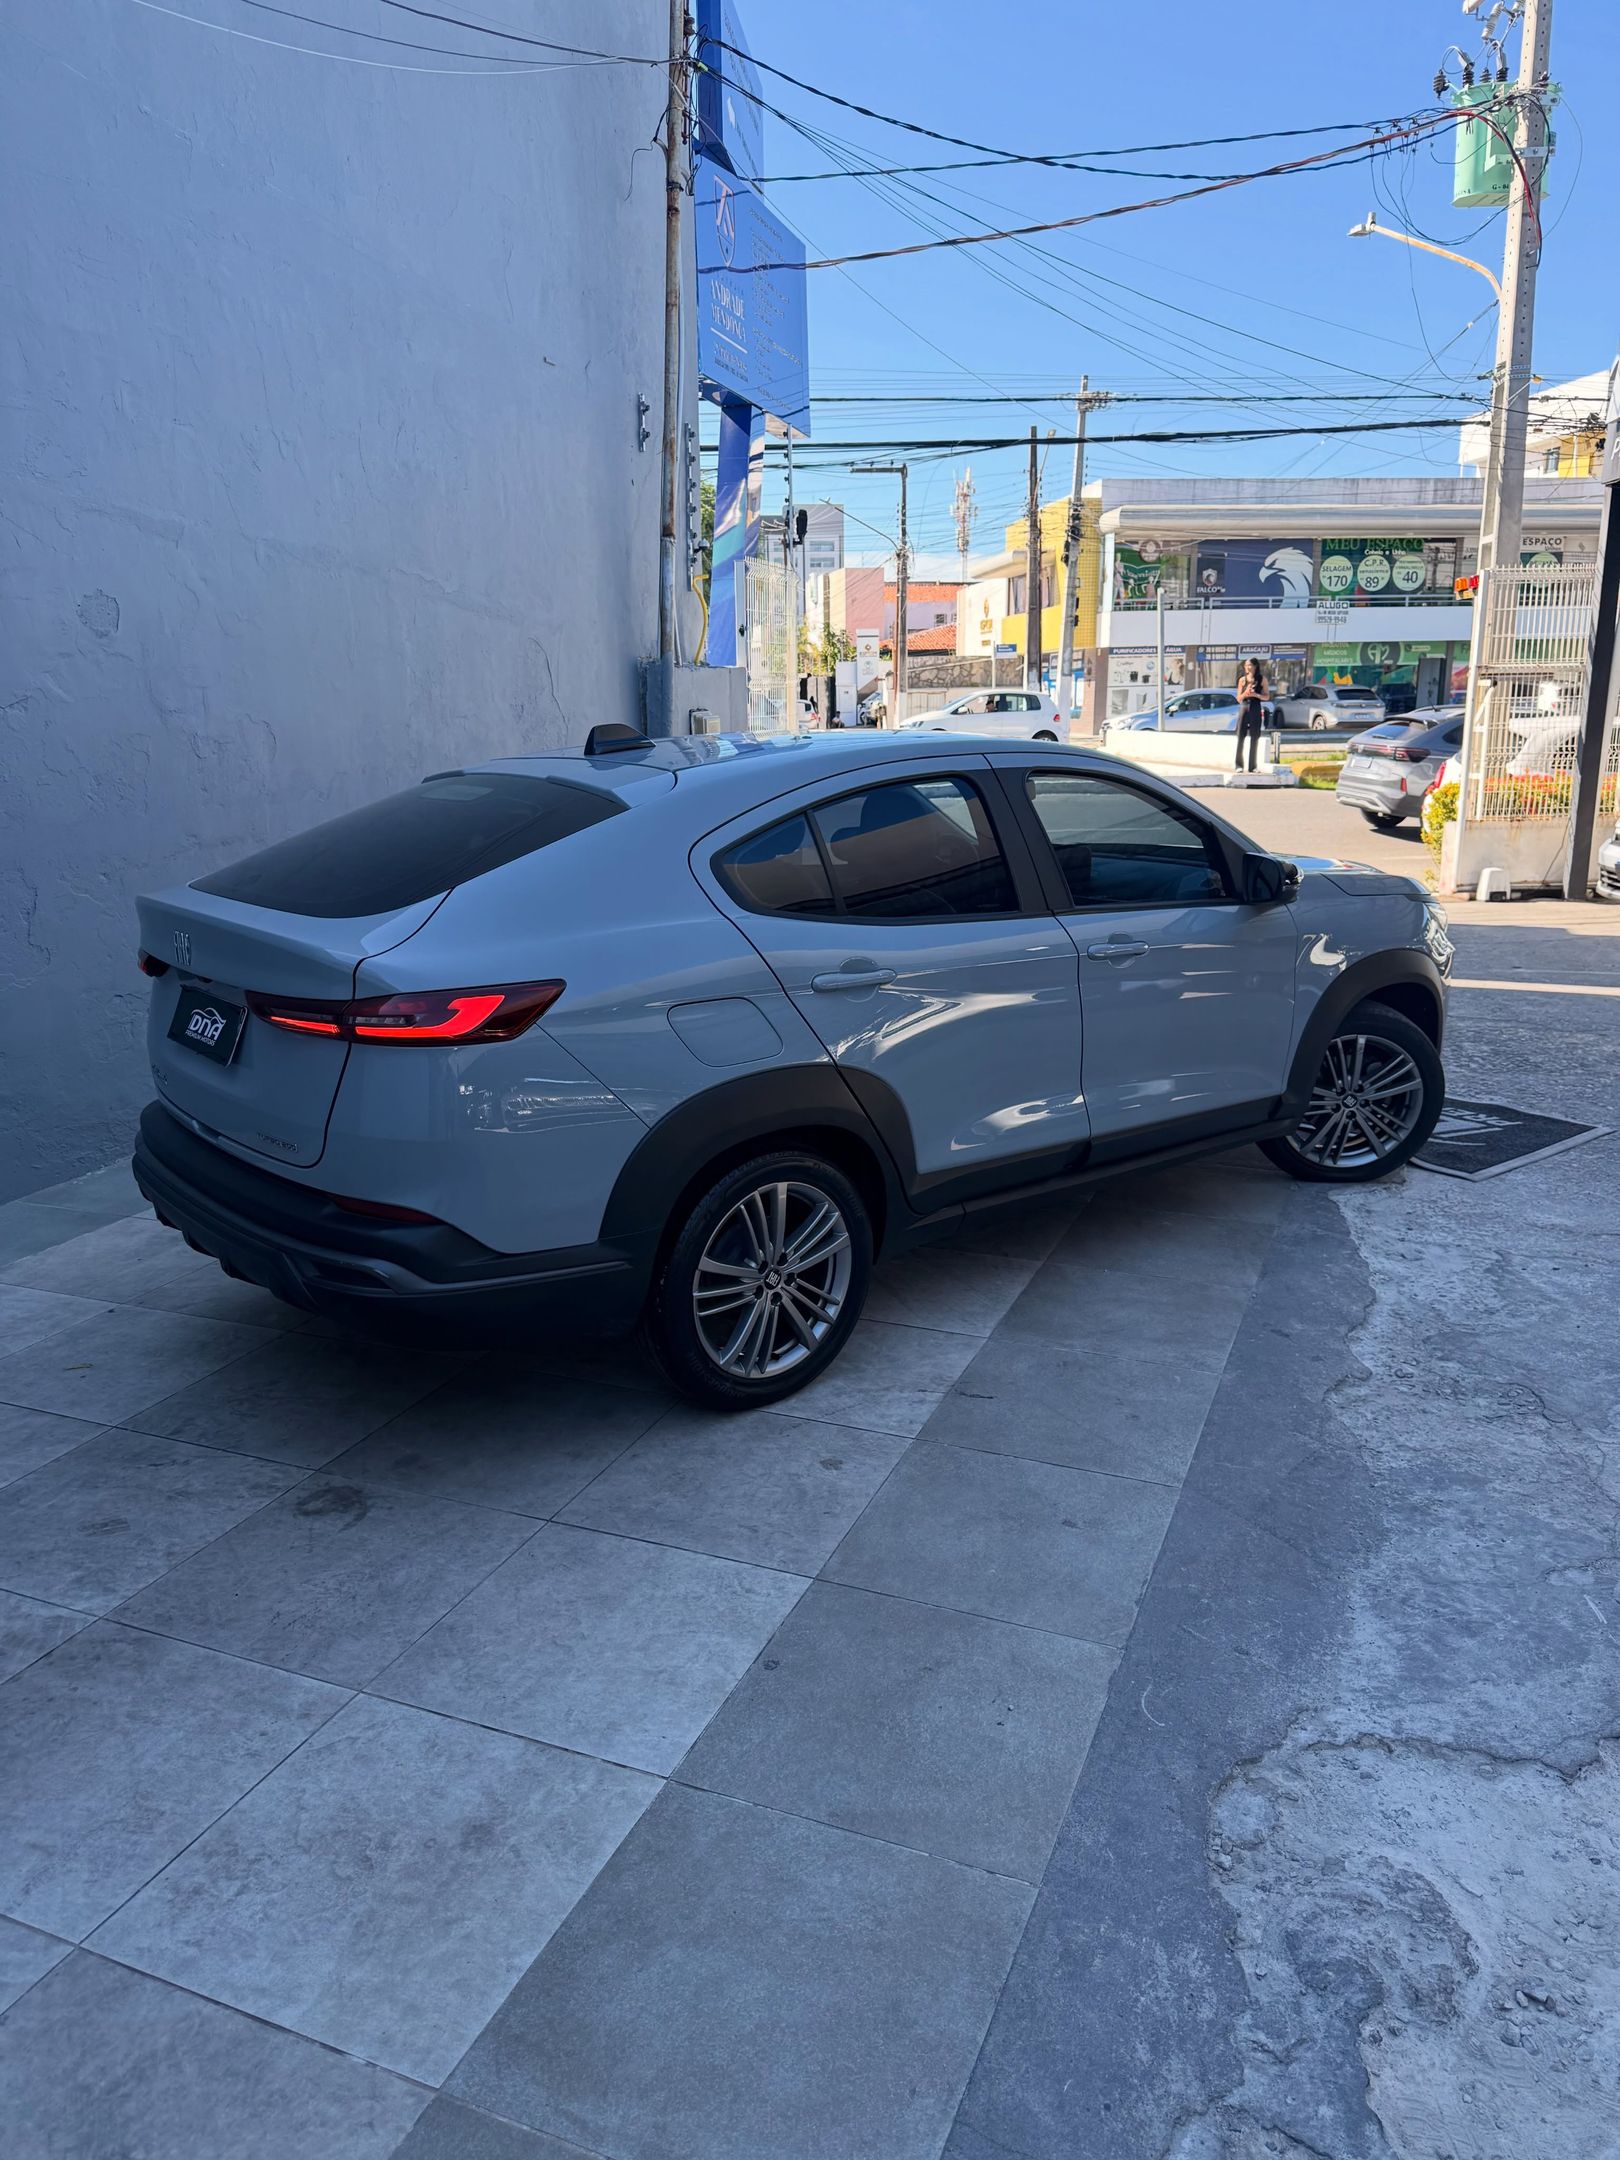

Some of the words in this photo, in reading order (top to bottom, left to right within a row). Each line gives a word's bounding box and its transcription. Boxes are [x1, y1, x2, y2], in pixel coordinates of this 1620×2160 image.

[1326, 538, 1360, 550] MEU
[1522, 537, 1562, 548] ESPAÇO
[1322, 565, 1352, 573] SELAGEM
[1326, 575, 1348, 588] 170
[1364, 576, 1380, 589] 89
[1402, 571, 1419, 584] 40
[188, 1014, 224, 1041] DNA
[185, 1029, 202, 1041] PREMIUM
[200, 1034, 217, 1047] MOTORS
